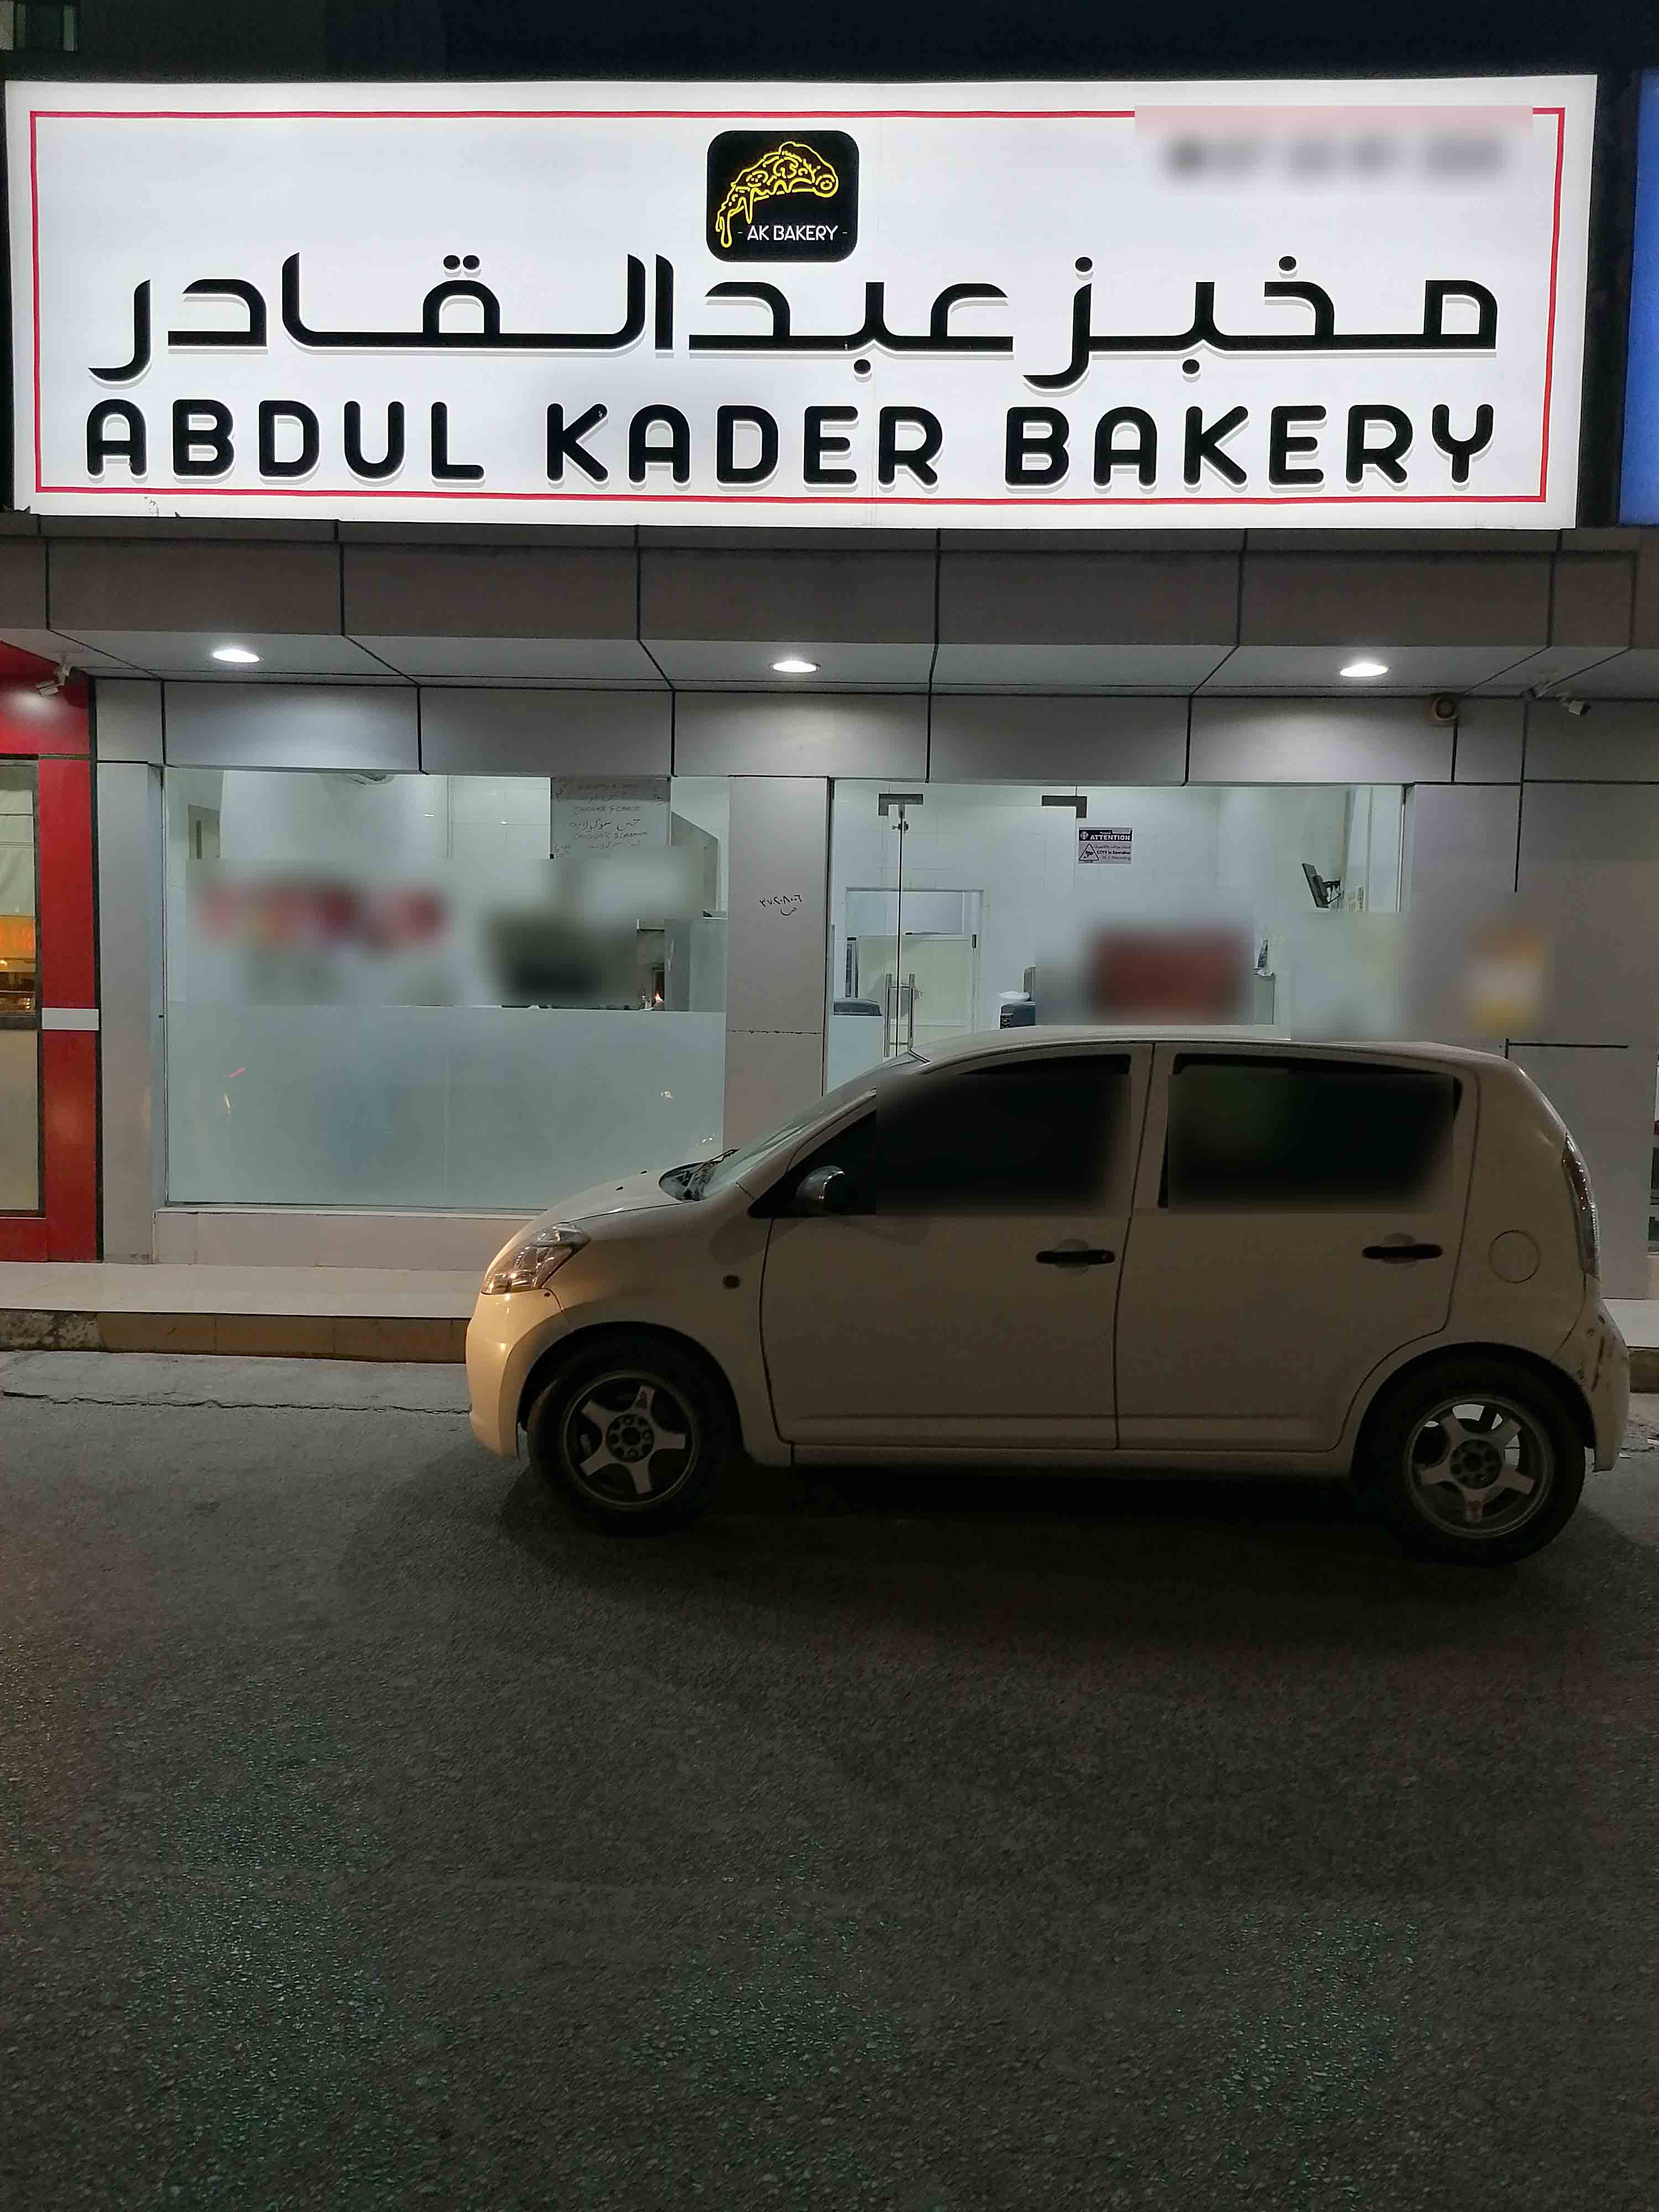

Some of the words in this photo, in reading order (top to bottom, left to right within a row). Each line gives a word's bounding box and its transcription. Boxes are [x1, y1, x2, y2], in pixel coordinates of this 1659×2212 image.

[747, 225, 770, 241] AK
[773, 225, 838, 241] BAKERY
[1023, 255, 1498, 389] مخبز
[86, 399, 484, 480] ABDUL
[547, 403, 942, 486] KADER
[1005, 404, 1494, 486] BAKERY
